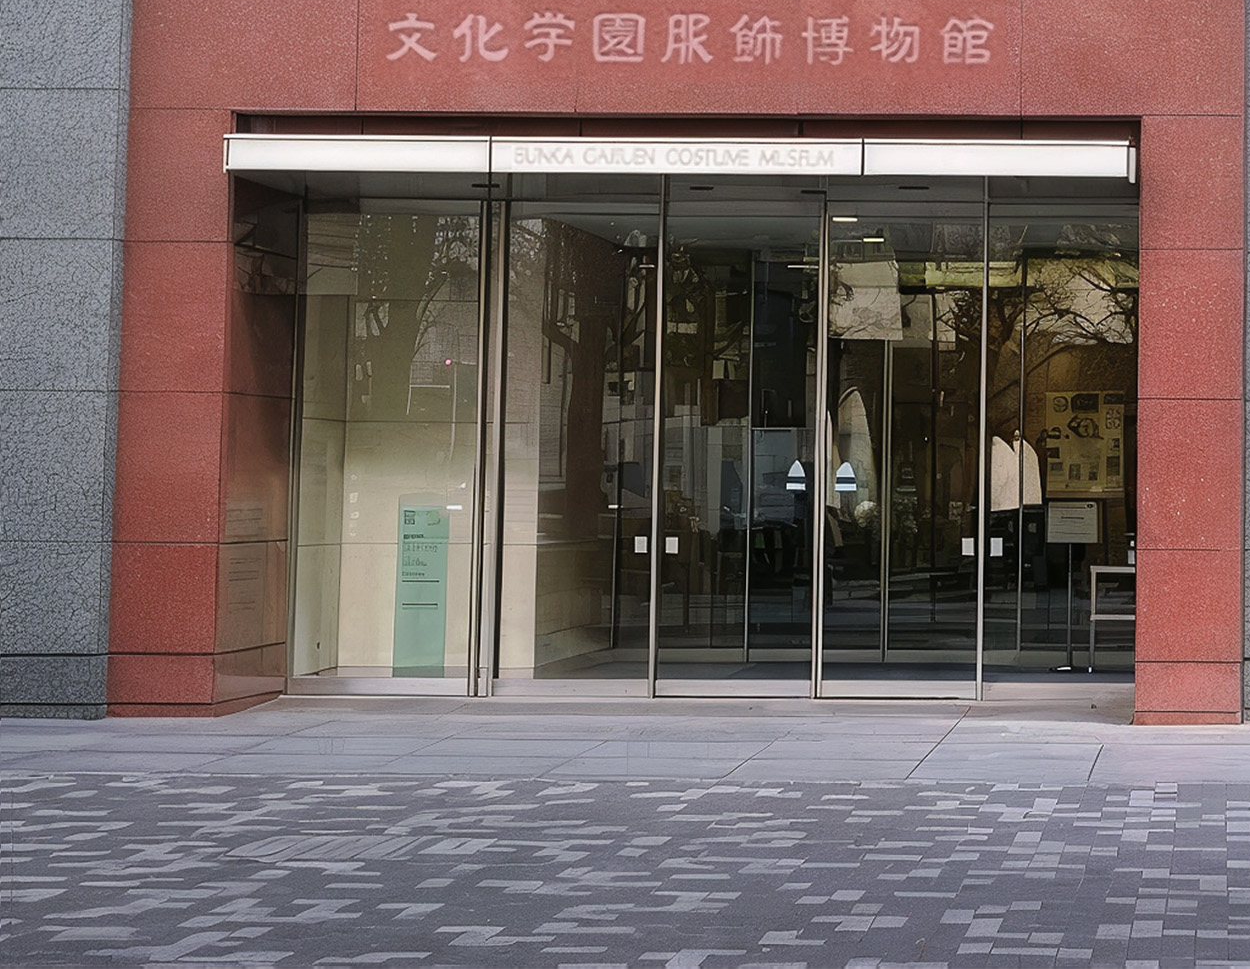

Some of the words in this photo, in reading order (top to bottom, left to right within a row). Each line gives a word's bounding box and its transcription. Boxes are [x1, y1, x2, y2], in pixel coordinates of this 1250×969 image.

[385, 10, 996, 68] 文化学園服飾博物館
